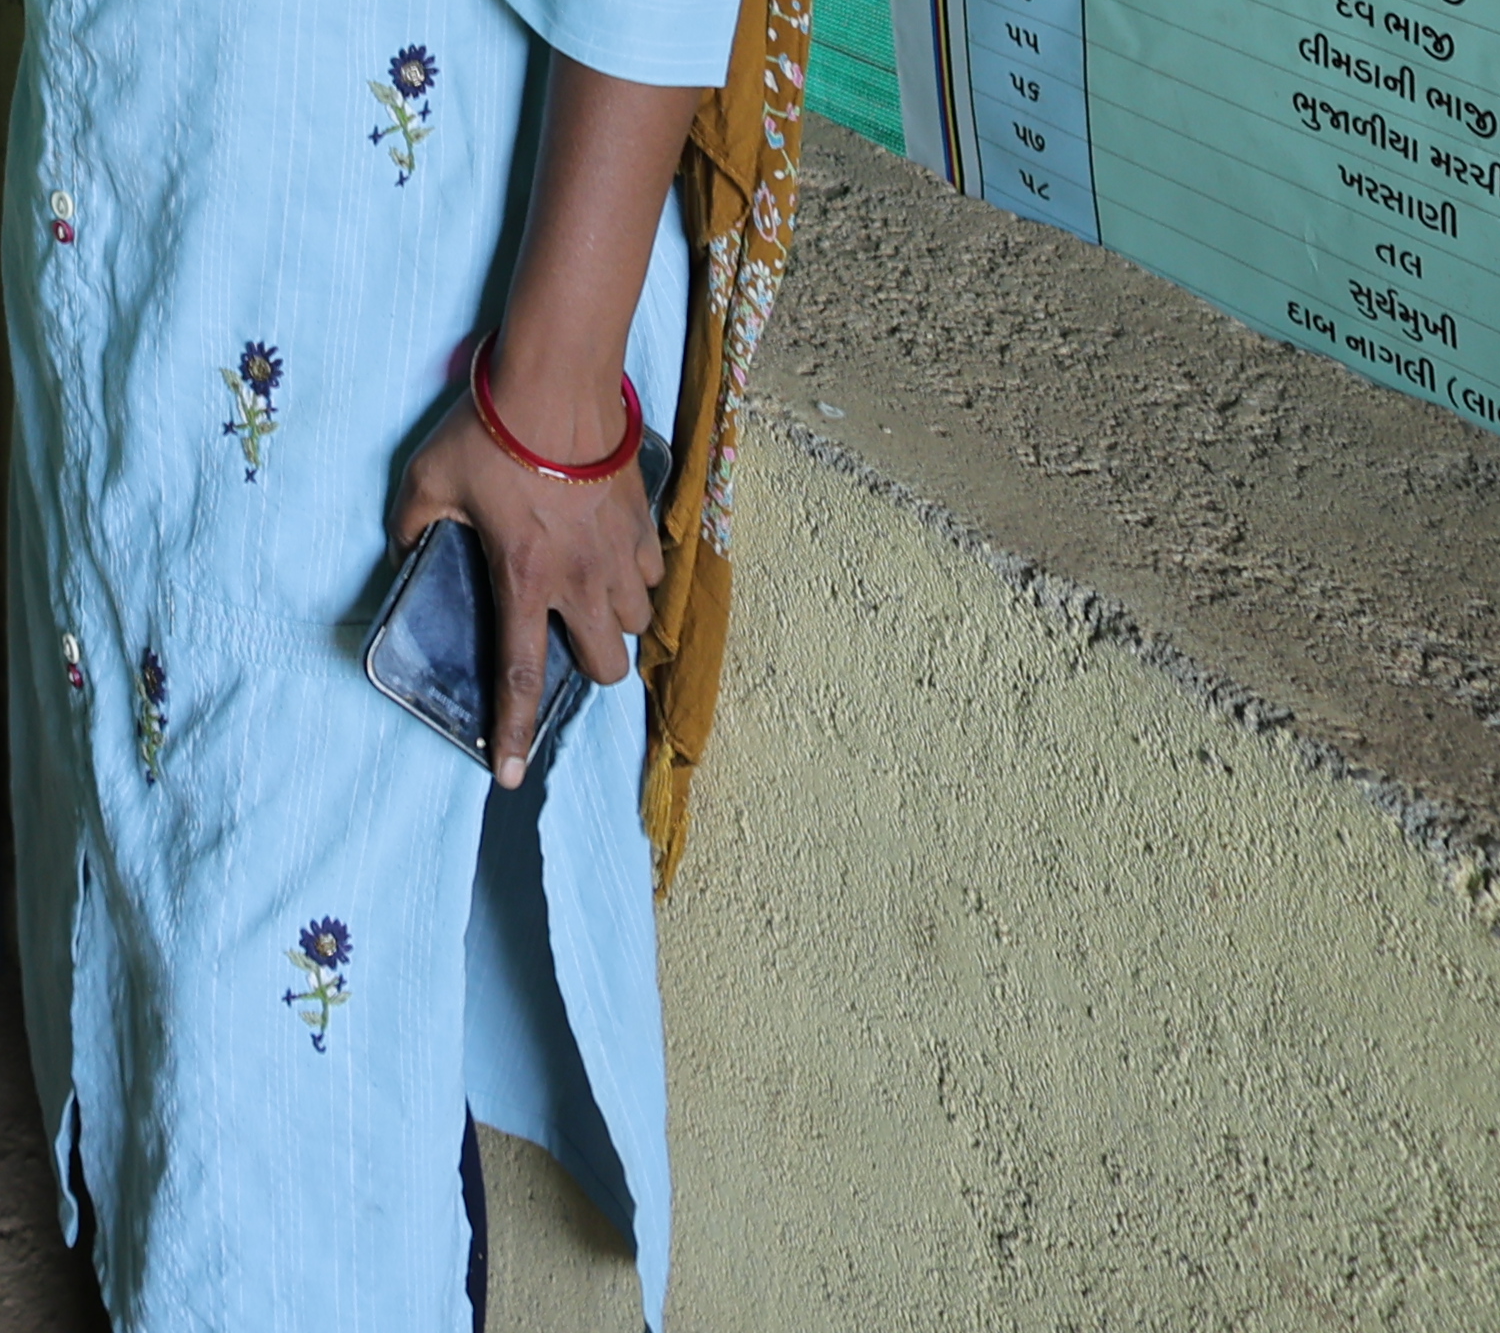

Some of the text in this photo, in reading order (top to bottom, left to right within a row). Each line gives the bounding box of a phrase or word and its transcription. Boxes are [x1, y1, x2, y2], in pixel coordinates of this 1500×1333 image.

[1384, 12, 1454, 62] ભાજી
[1010, 73, 1039, 102] ૫૬
[1299, 32, 1497, 139] લીમડાની ભાજી
[1020, 170, 1049, 200] ૫૮
[1338, 165, 1457, 238] ખરસાણી
[1375, 244, 1422, 278] તલ
[1288, 301, 1336, 343] દાબ
[1345, 335, 1435, 392] નાગલી
